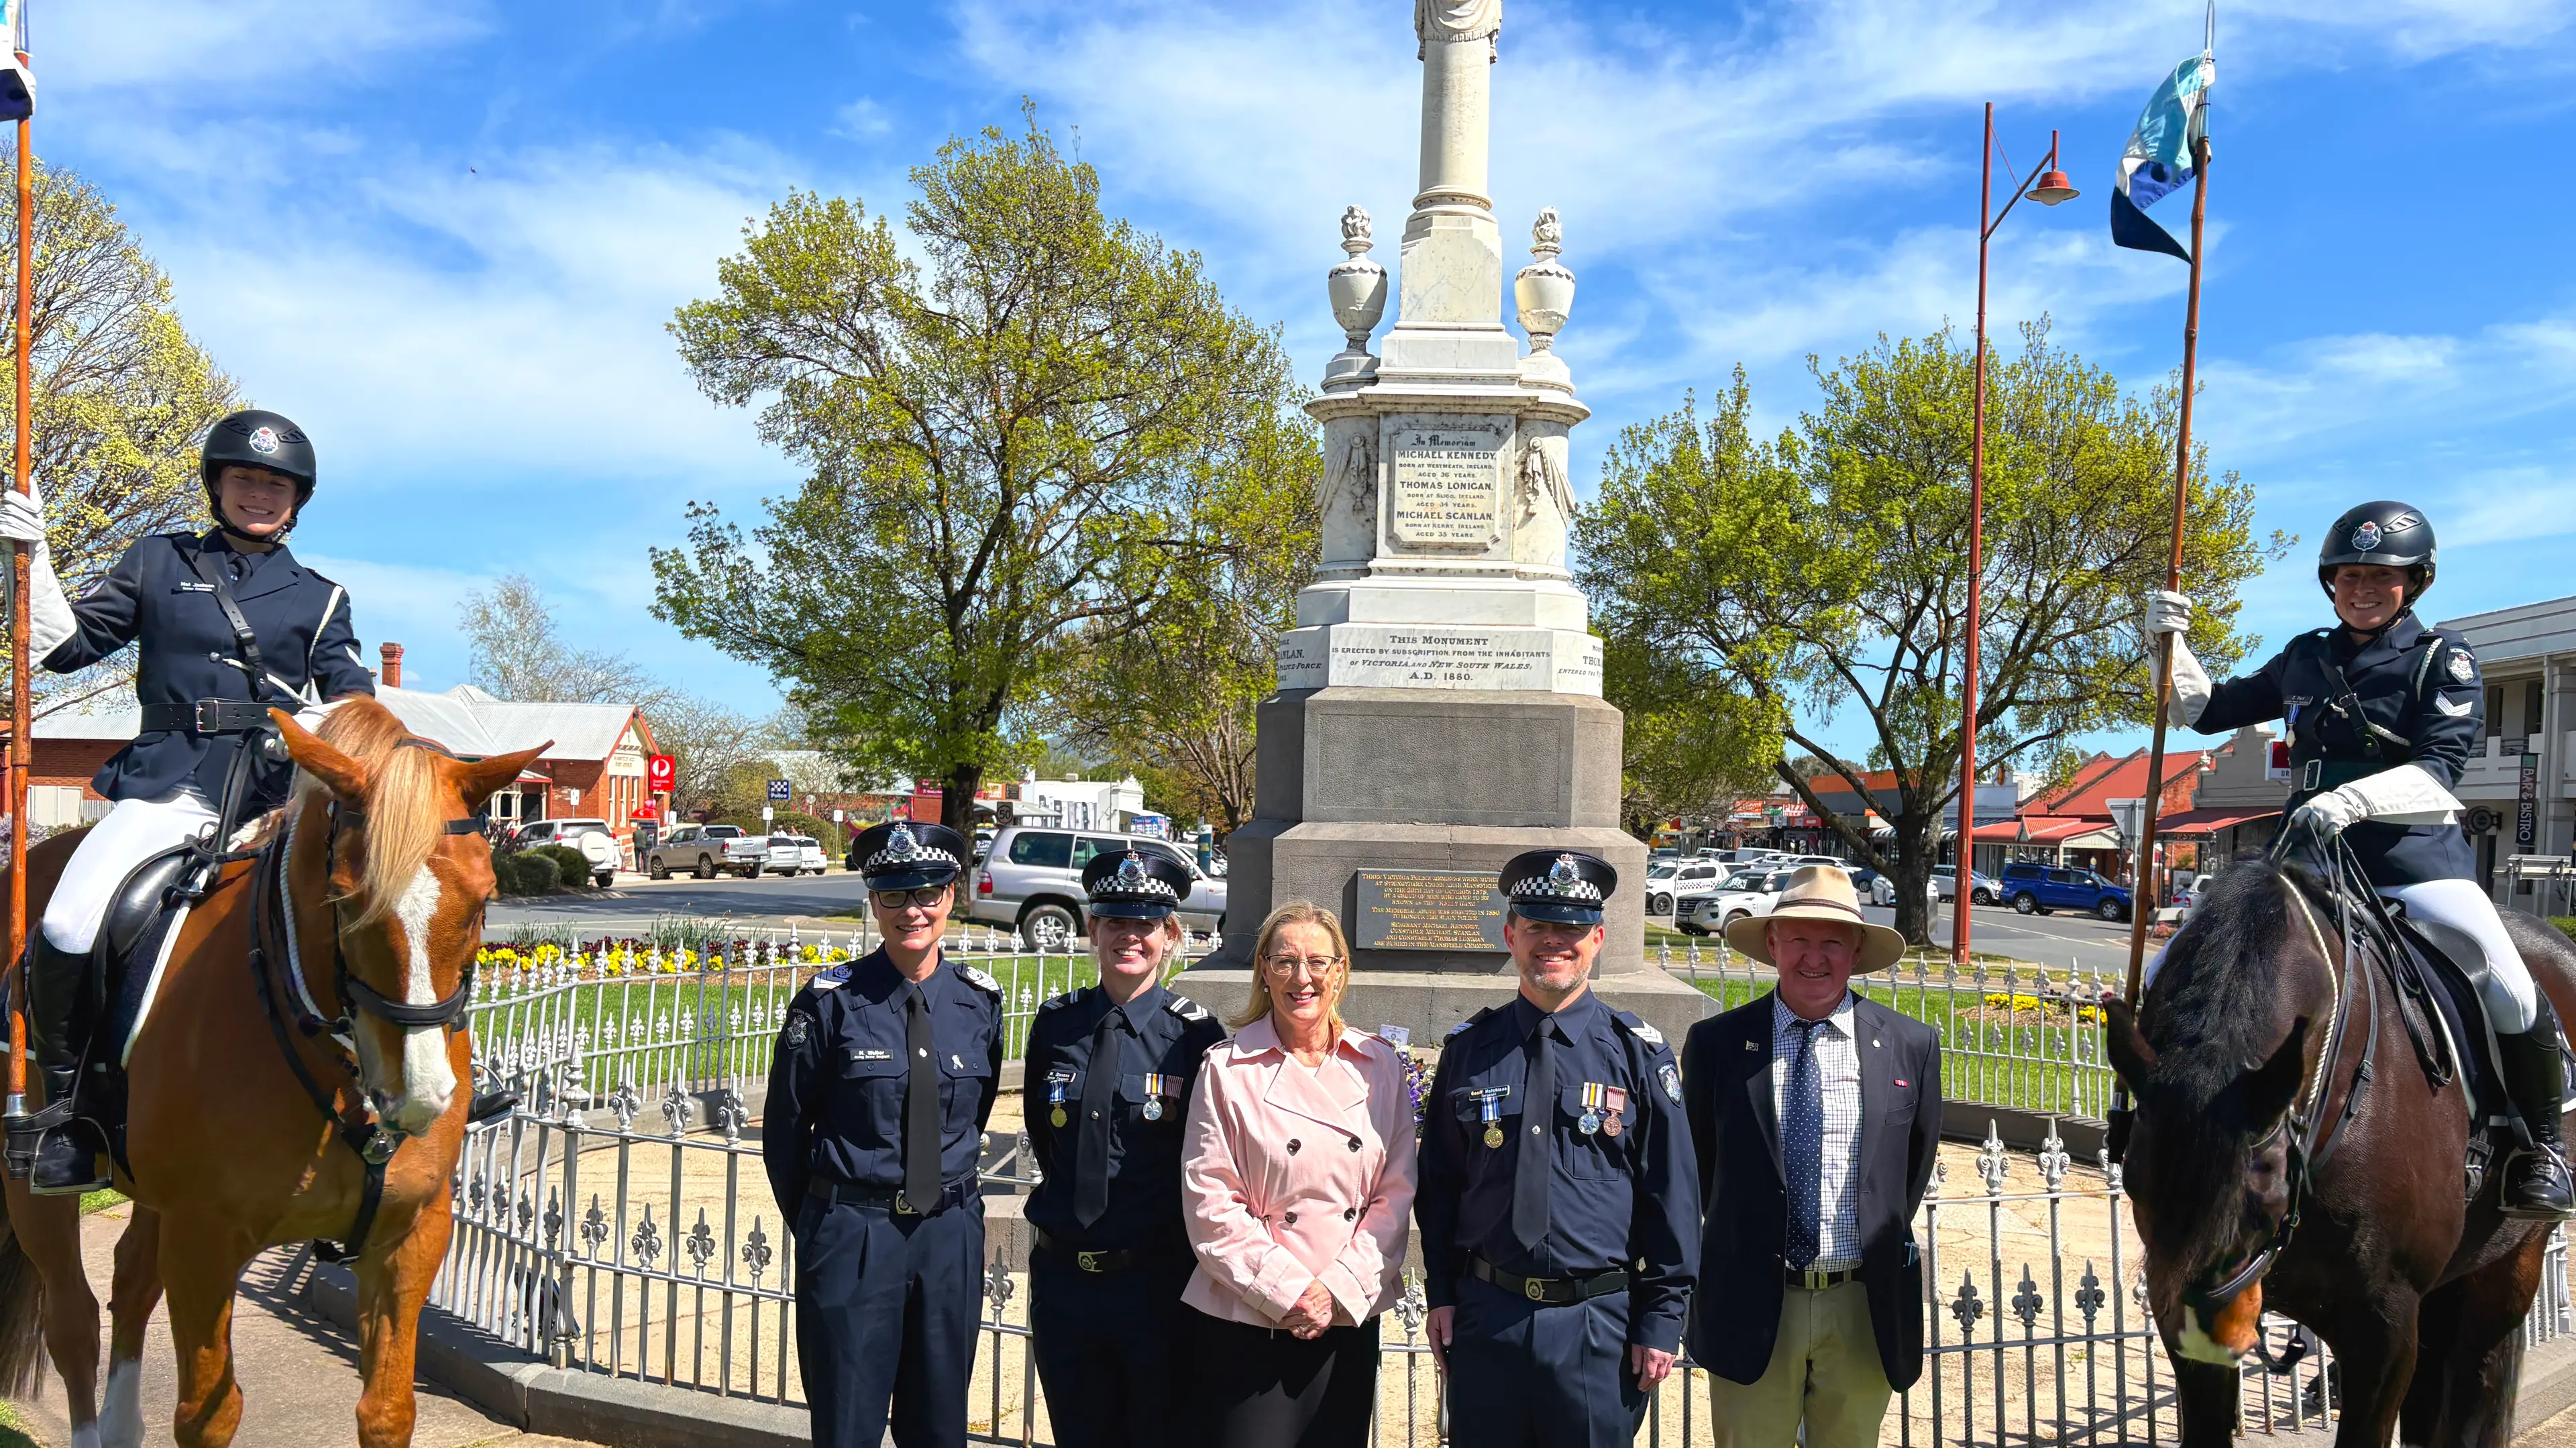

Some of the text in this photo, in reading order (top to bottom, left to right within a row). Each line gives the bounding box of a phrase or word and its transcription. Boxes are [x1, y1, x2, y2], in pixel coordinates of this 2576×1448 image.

[1410, 434, 1476, 447] In Memoriam
[1397, 451, 1443, 459] MICHAEL
[1400, 481, 1443, 490] THOMAS
[1397, 511, 1443, 519] MICHAEL
[1389, 635, 1489, 646] THIS MONUMENT
[1428, 660, 1454, 668] NEW
[1456, 661, 1490, 669] SOUTH
[1409, 672, 1436, 680] A.D.
[2519, 768, 2534, 841] BAR & BISTRO
[999, 810, 1012, 820] 50
